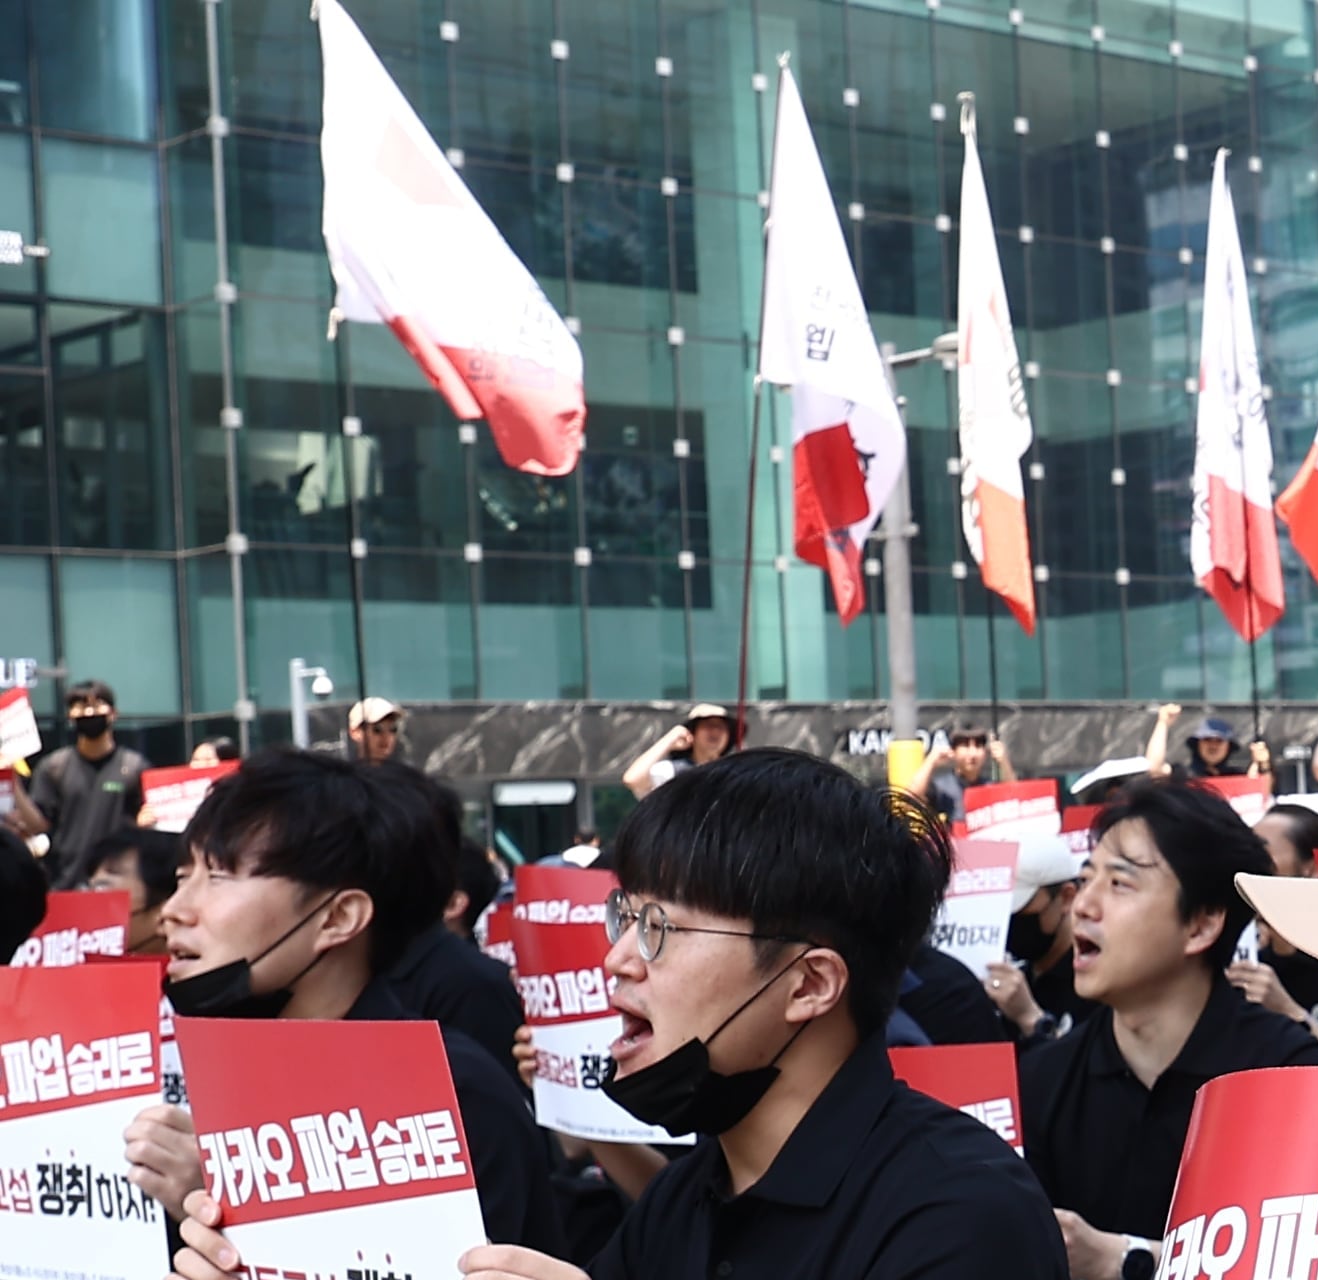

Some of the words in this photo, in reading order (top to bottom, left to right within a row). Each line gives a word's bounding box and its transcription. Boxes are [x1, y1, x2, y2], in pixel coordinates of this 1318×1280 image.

[554, 966, 610, 1016] 파업
[66, 1031, 156, 1096] 승리로
[199, 1121, 305, 1208] 카카오
[290, 1107, 380, 1194] 파업
[371, 1109, 467, 1185] 승리로
[37, 1162, 94, 1219] 쟁취
